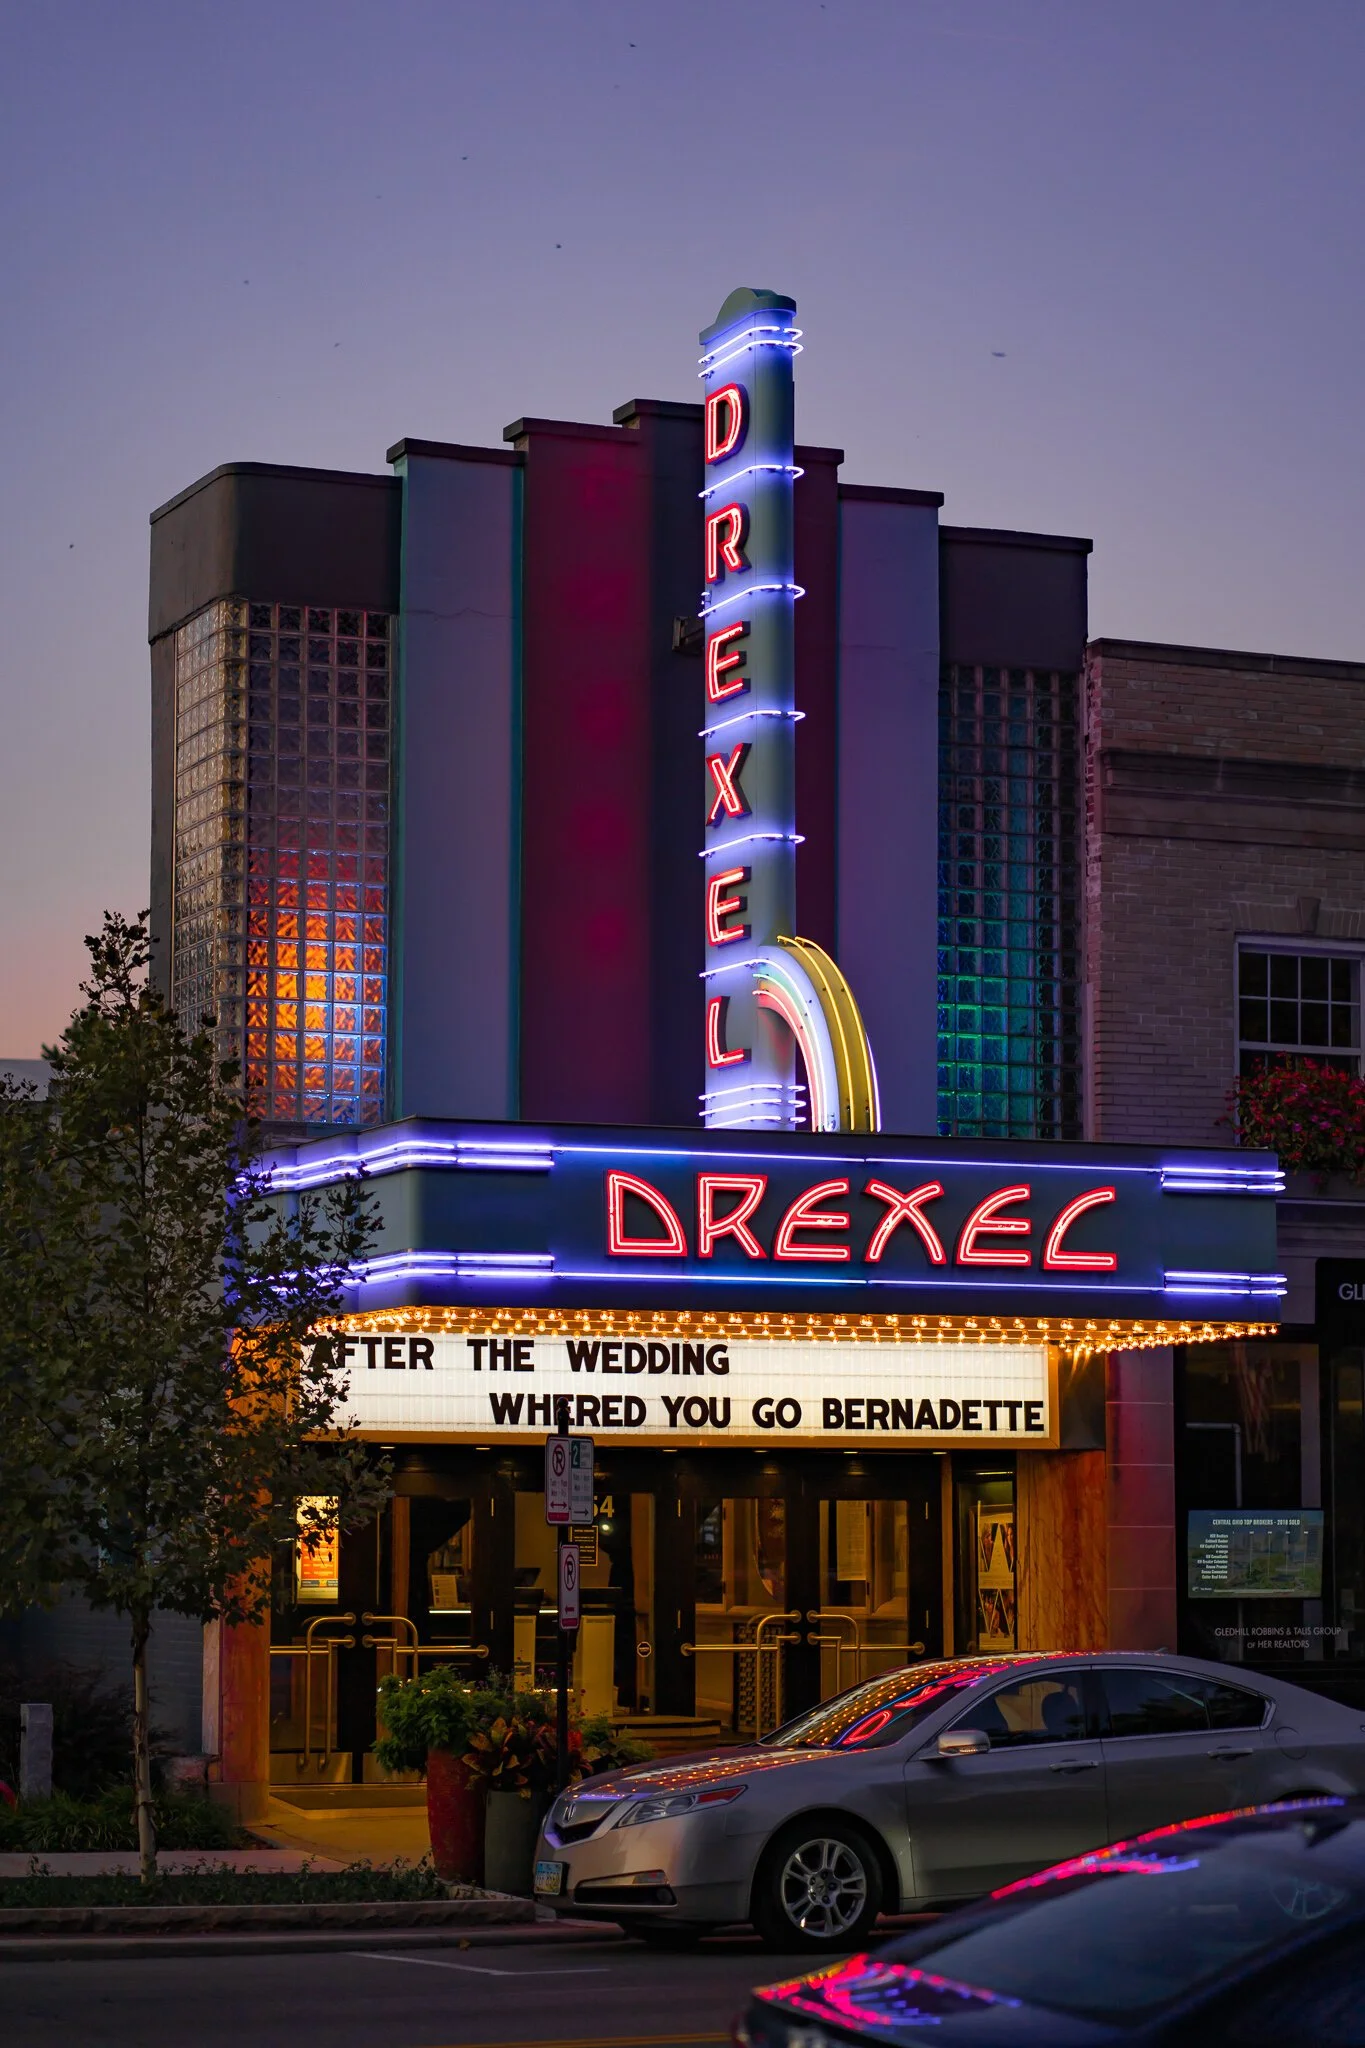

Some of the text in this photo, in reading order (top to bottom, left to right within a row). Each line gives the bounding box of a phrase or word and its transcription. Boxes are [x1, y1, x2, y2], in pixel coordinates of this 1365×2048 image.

[704, 381, 752, 1071] DREXEL
[1338, 1282, 1365, 1301] GL
[466, 1338, 535, 1372] THE
[565, 1340, 730, 1375] WEDDING
[661, 1395, 731, 1428] YOU
[751, 1396, 802, 1430] GO
[821, 1397, 1045, 1432] BERNADETTE
[1214, 1627, 1250, 1637] GLEDHILL
[1251, 1627, 1285, 1636] ROBBINS
[1313, 1626, 1342, 1636] GROUP
[1257, 1640, 1272, 1648] HER
[1274, 1640, 1310, 1648] REALTORS
